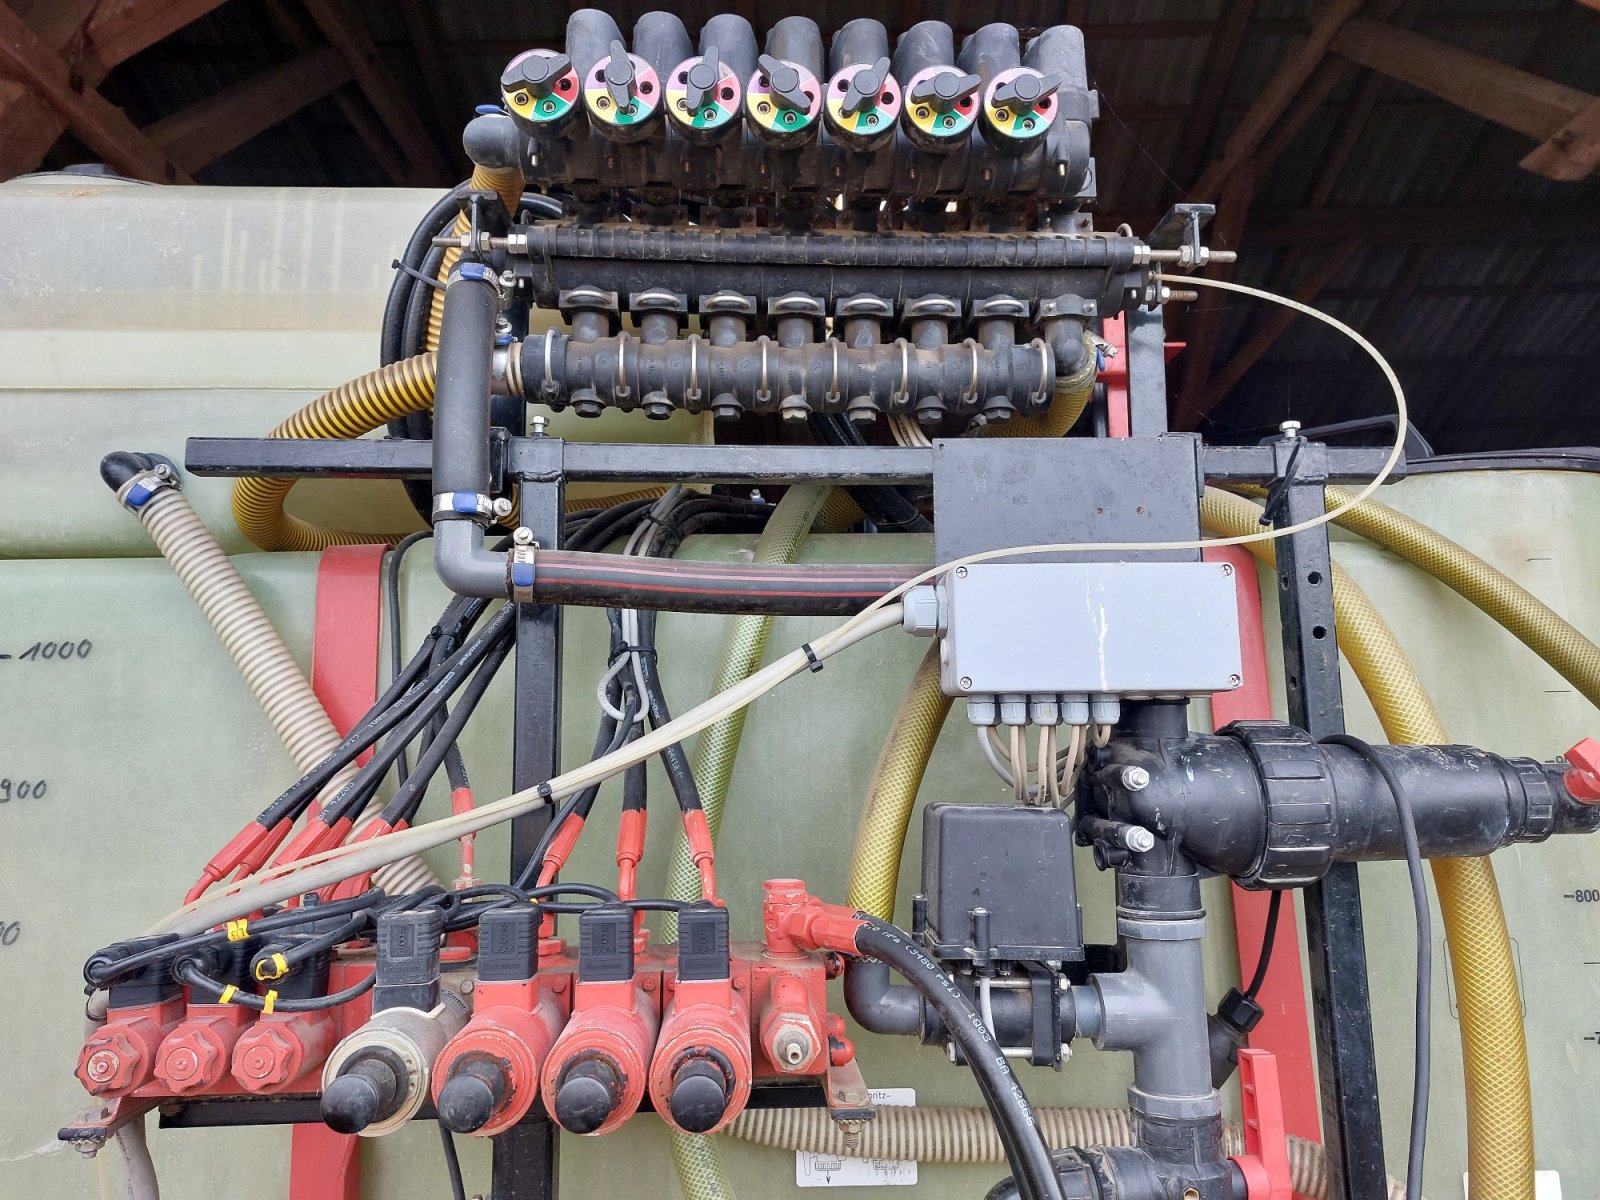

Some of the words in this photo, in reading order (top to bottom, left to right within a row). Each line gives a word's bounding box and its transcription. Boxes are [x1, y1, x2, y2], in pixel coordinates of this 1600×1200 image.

[19, 638, 92, 662] 1000
[0, 777, 47, 804] 900
[1574, 889, 1600, 903] 800
[995, 1056, 1010, 1075] BA
[1011, 1081, 1035, 1127] 42866
